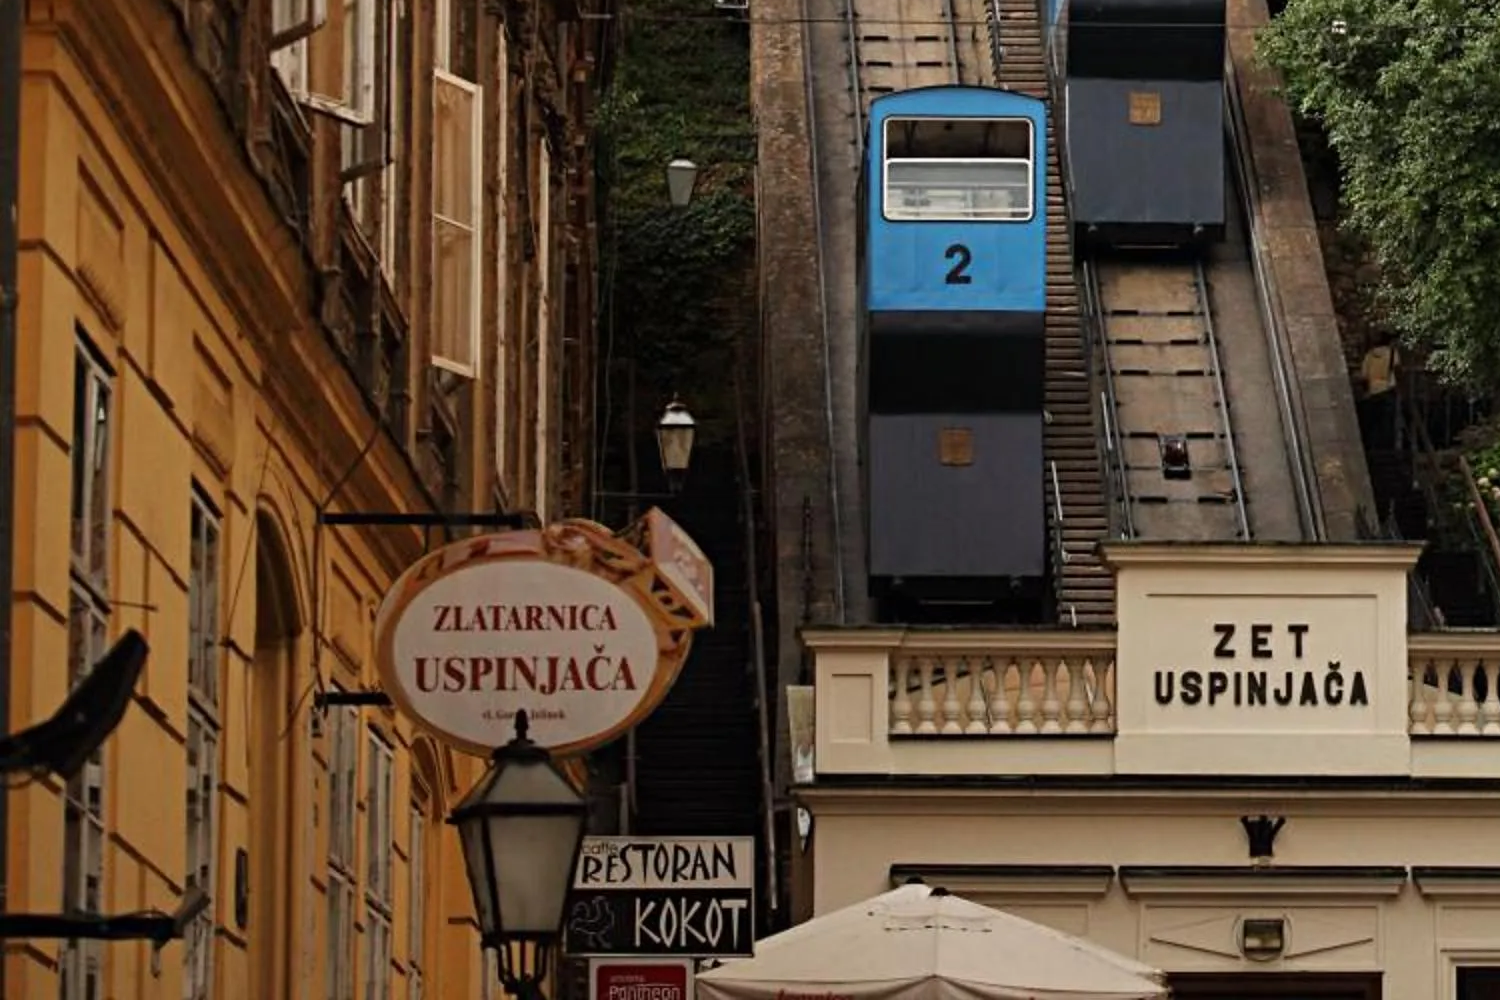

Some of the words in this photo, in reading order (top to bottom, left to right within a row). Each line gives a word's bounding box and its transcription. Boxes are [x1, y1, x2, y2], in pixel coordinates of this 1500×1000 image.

[944, 244, 973, 285] 2
[433, 604, 617, 632] ZLATARNICA
[1212, 623, 1311, 659] ZET
[414, 645, 637, 695] USPINJAČA
[1153, 661, 1369, 707] USPINJAČA
[582, 843, 737, 884] RESTORAN
[635, 897, 748, 949] KOKOT
